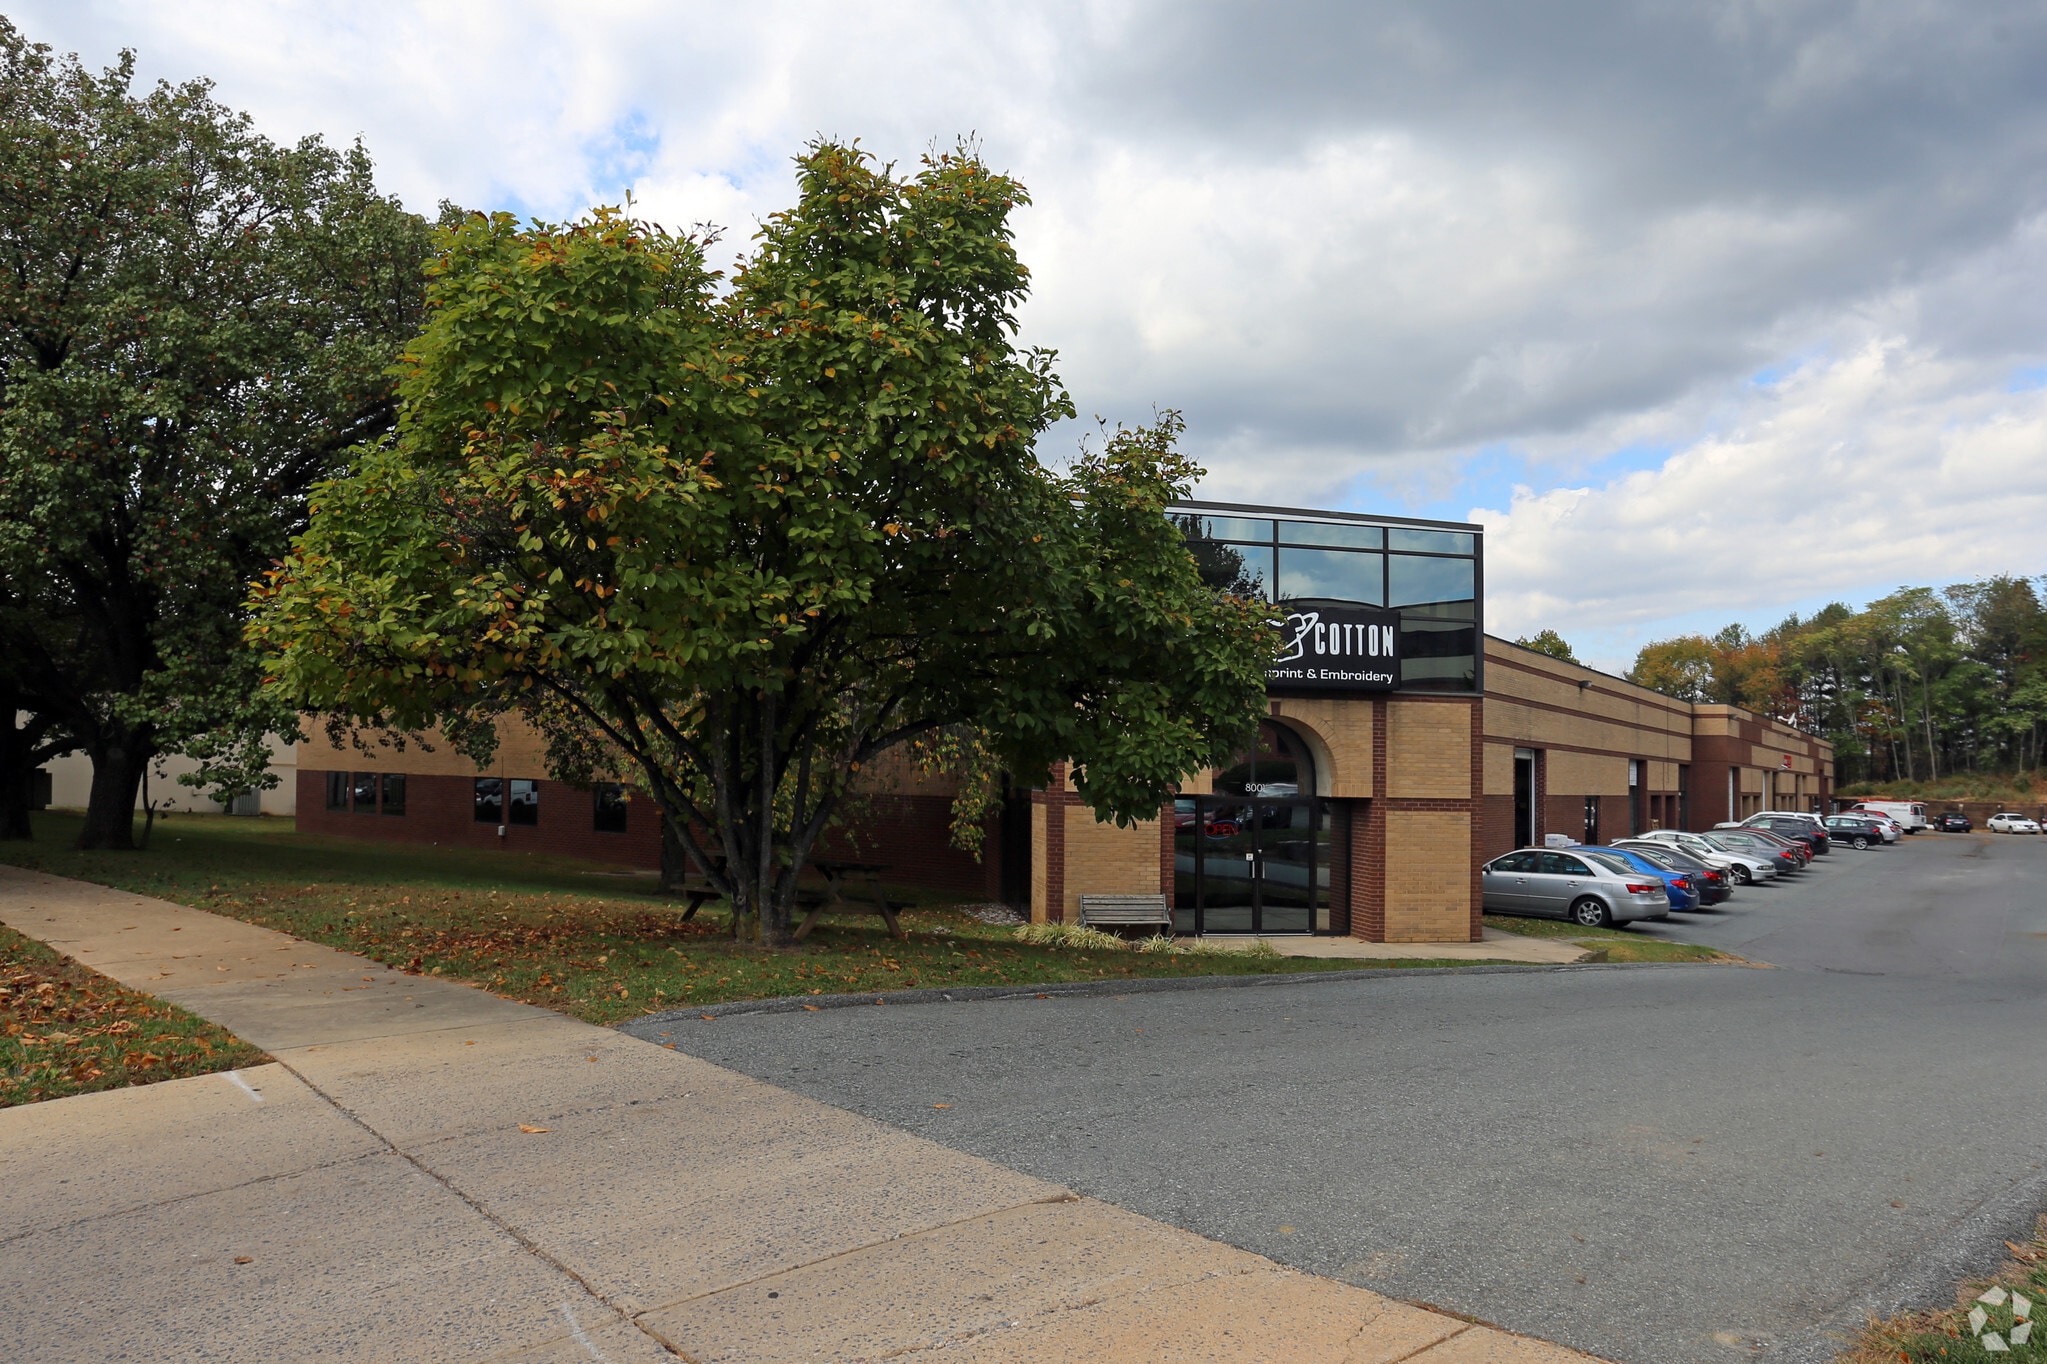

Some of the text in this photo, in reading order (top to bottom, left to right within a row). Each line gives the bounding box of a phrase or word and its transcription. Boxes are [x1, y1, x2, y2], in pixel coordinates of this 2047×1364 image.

[1315, 622, 1394, 657] COTTON
[1306, 668, 1318, 679] &
[1320, 668, 1394, 684] Embroidery
[1203, 823, 1239, 836] OPEN
